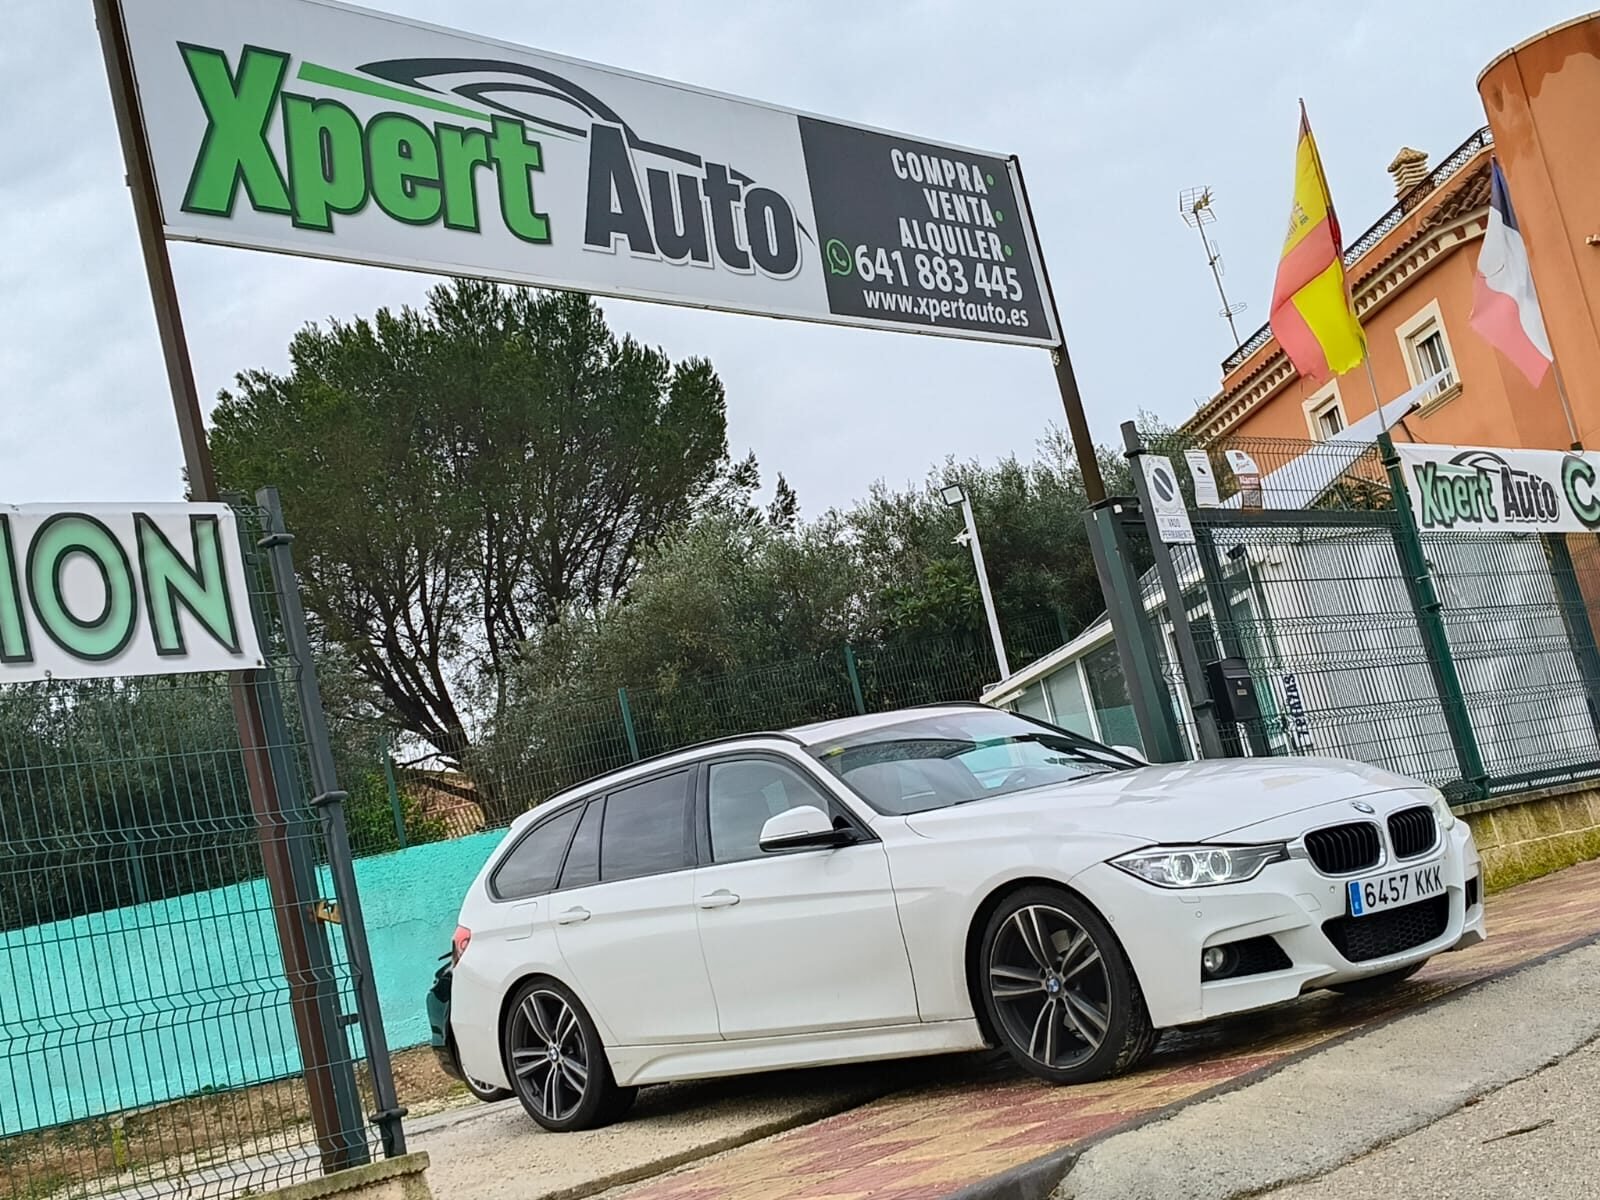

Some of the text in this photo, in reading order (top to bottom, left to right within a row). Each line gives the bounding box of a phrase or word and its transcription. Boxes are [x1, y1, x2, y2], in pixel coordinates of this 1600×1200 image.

[176, 40, 802, 279] Xpert Auto
[890, 148, 988, 194] COMPRA
[923, 188, 996, 228] VENTA
[899, 217, 1005, 262] ALQUILER
[855, 244, 1023, 302] 641 883 445
[863, 289, 1029, 327] www.xpertauto.es
[1413, 461, 1499, 528] Xpert
[1500, 465, 1560, 522] Auto
[1365, 865, 1443, 908] 6457 KKK
